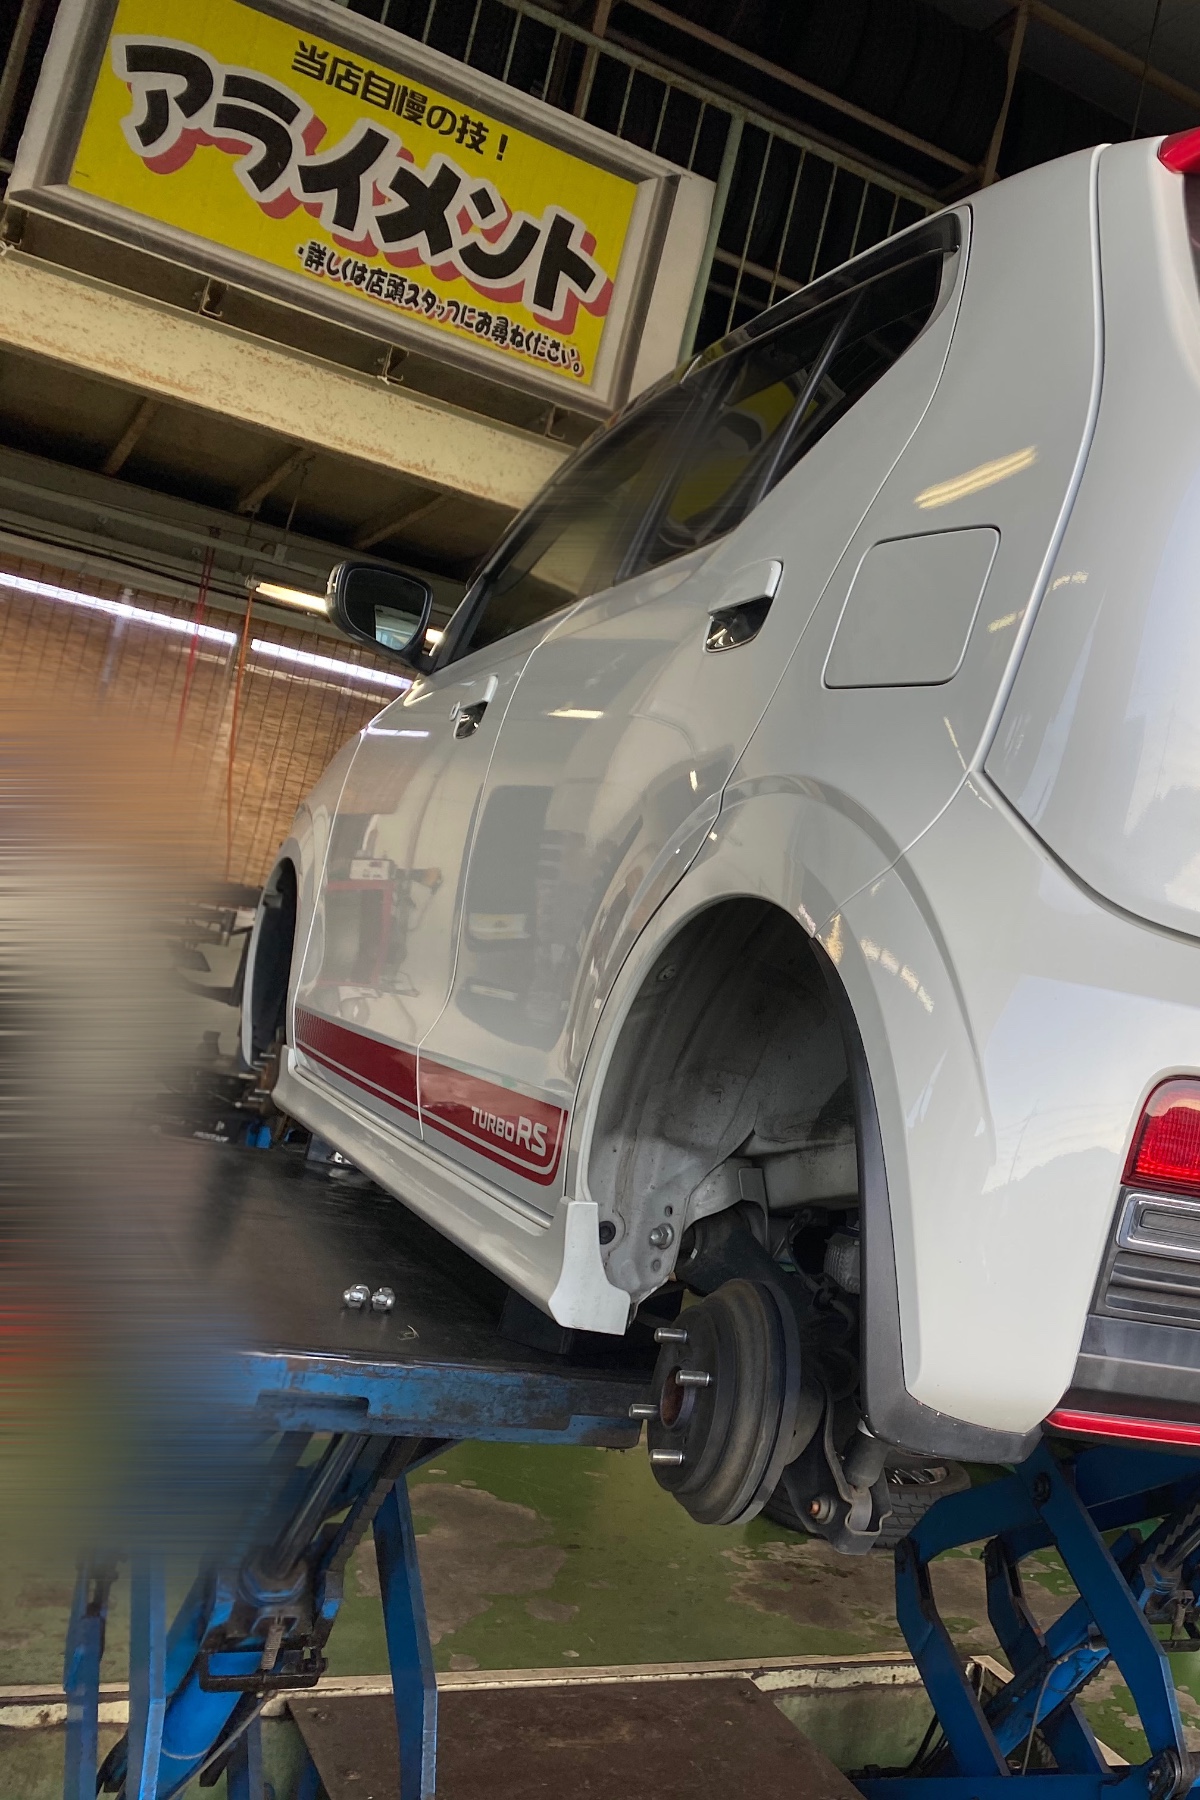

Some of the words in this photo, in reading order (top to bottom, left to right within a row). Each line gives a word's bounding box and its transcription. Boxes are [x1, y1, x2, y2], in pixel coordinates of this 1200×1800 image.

[124, 44, 597, 311] アライメント
[471, 1106, 515, 1142] TURBO
[516, 1115, 548, 1157] RS
